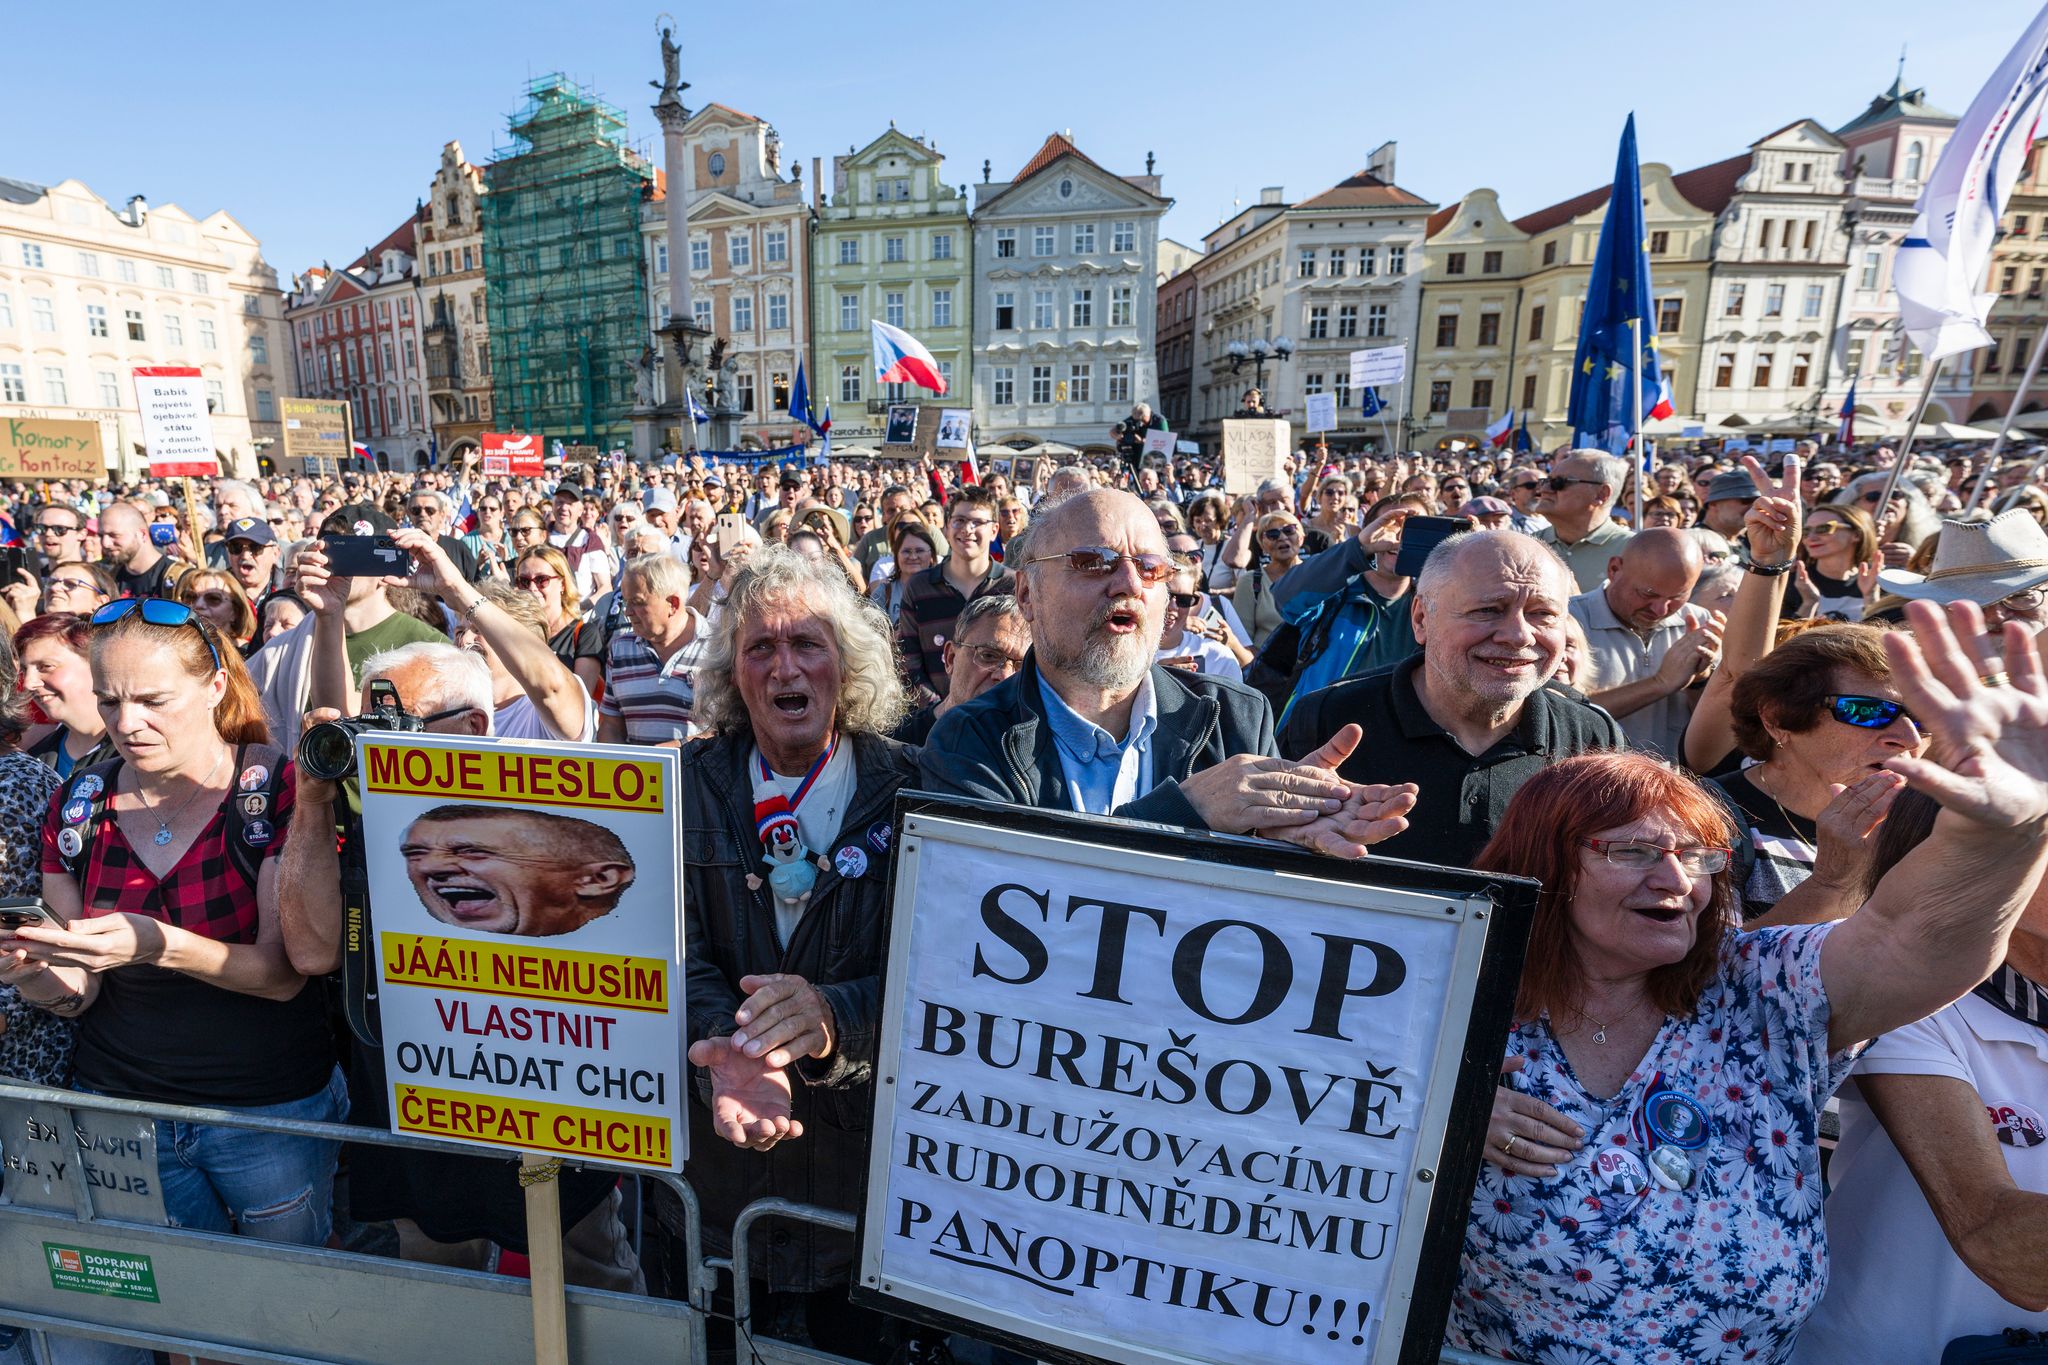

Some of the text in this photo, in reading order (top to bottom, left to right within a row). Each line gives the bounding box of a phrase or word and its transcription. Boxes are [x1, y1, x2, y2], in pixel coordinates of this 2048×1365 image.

[154, 388, 188, 396] Babiš
[369, 747, 658, 803] MOJE HESLO:
[348, 907, 361, 952] Nikon
[388, 937, 663, 1002] JÁÁ!! NEMUSÍM
[972, 883, 1406, 1043] STOP
[434, 998, 617, 1051] VLASTNIT
[397, 1041, 665, 1105] OVLÁDAT CHCI
[913, 999, 1403, 1141] BUREŠOVĚ
[401, 1088, 667, 1159] ČERPAT CHCI!!
[911, 1081, 1398, 1205] ZADLUŽOVACÍMU
[902, 1131, 1393, 1261] RUDOHNĚDÉMU
[56, 1274, 79, 1283] PRODEJ
[88, 1279, 122, 1288] PRONÁJEM
[130, 1284, 152, 1293] SERVIS
[85, 1255, 148, 1271] DOPRAVNÍ
[88, 1266, 140, 1281] ZNAČENÍ
[894, 1197, 1372, 1346] PANOPTIKU!!!
